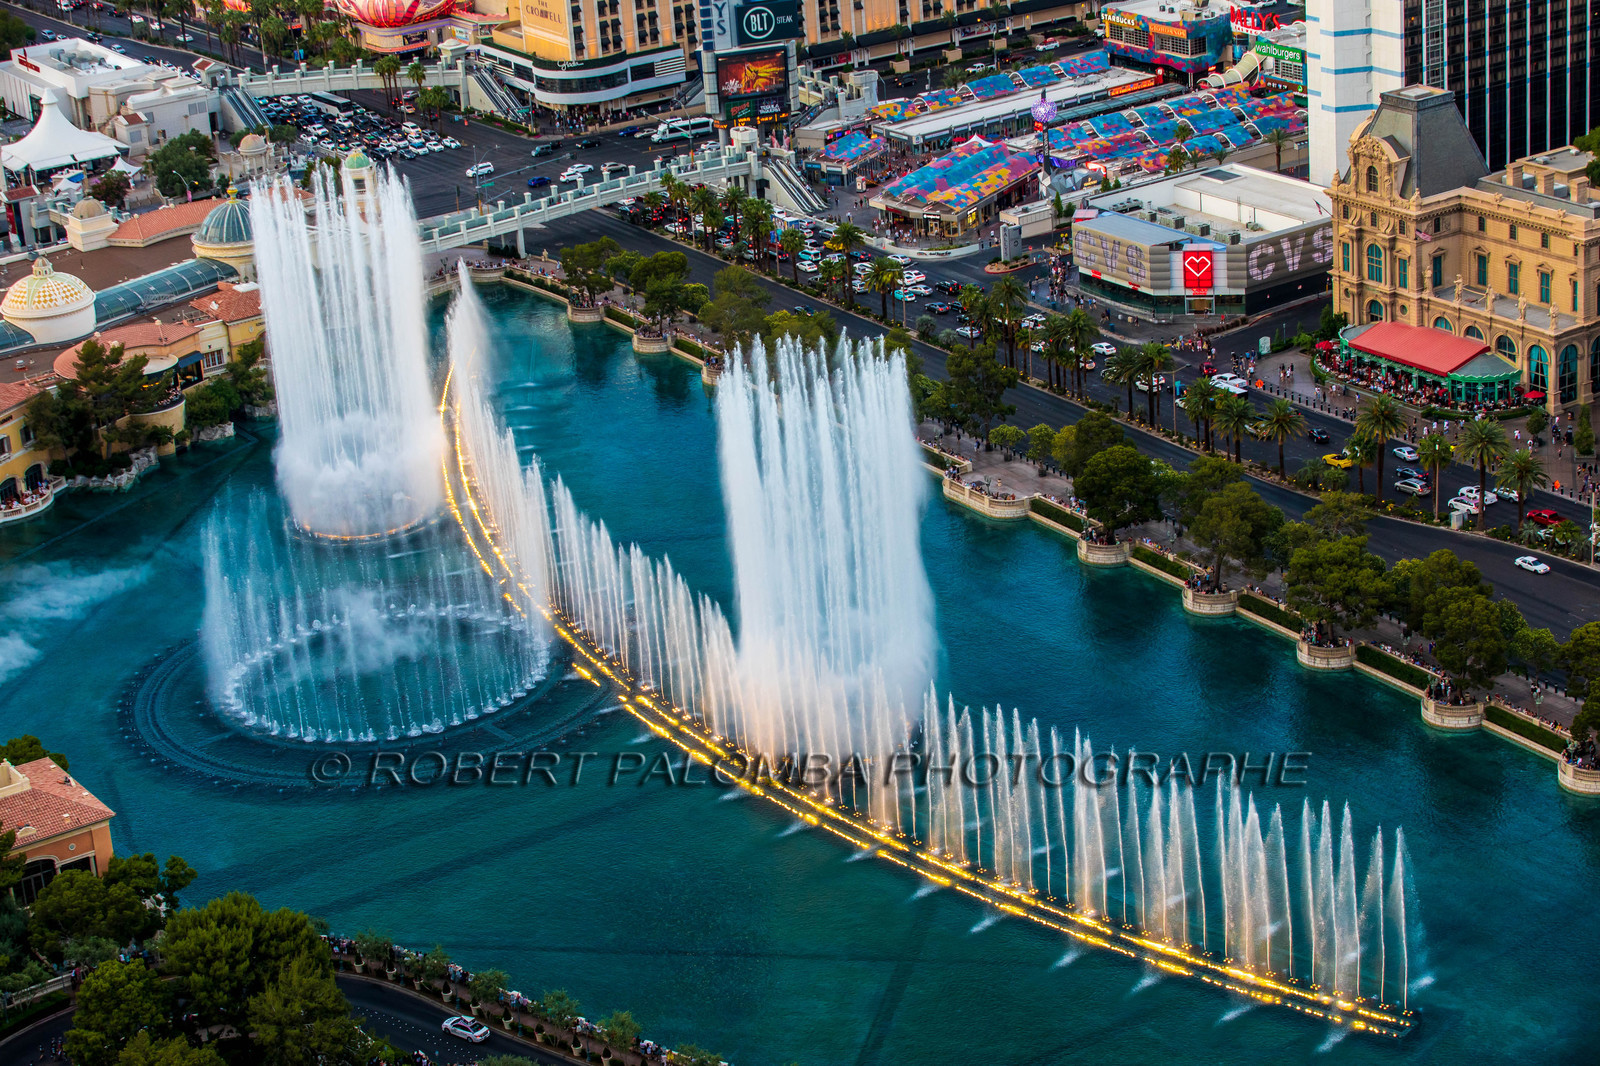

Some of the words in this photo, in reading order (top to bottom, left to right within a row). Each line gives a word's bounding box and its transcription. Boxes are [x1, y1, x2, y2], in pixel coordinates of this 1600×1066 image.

[750, 13, 768, 32] BLT
[776, 15, 793, 25] STEAK
[1101, 12, 1135, 26] STARBUCKS
[1230, 5, 1281, 31] BALLY'S
[1255, 44, 1301, 60] wahlburgers
[1074, 229, 1147, 282] CVS
[1248, 226, 1333, 280] CVS
